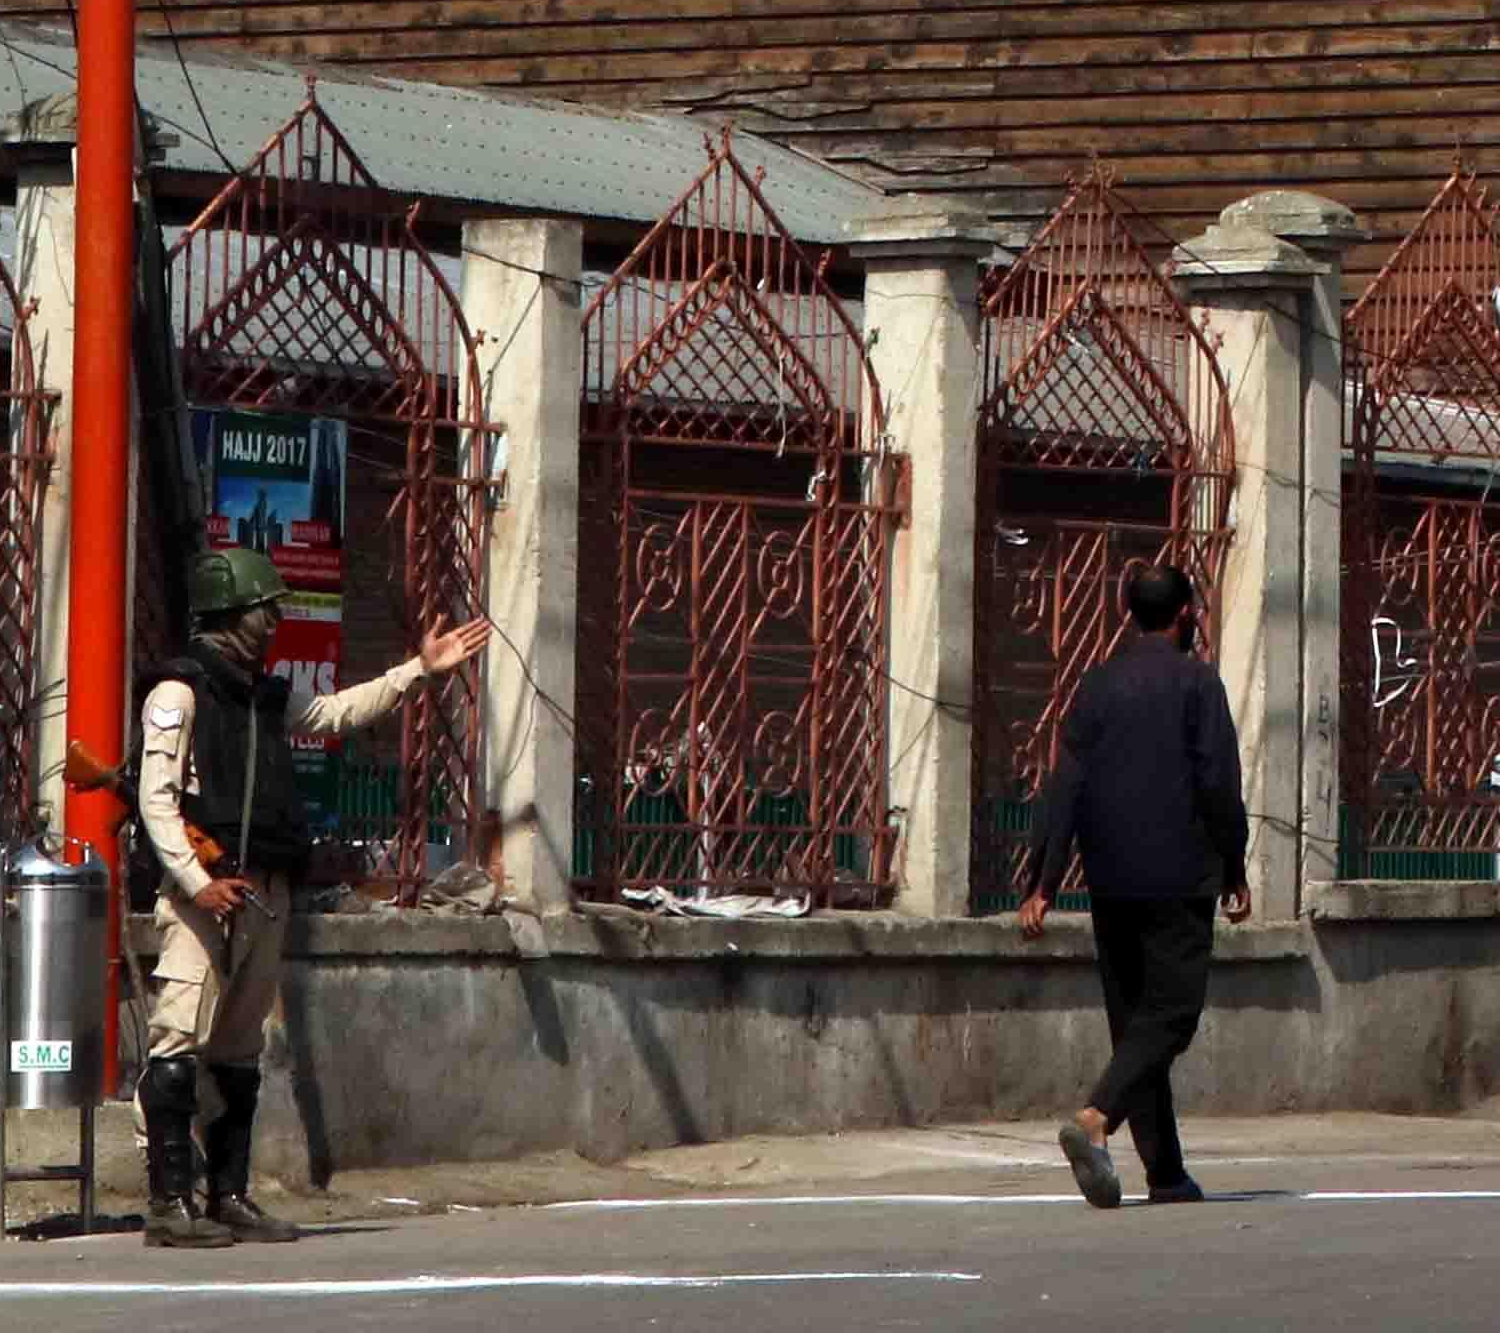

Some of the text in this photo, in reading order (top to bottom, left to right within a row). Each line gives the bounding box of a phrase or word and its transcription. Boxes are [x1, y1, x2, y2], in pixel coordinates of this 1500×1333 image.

[222, 429, 307, 465] HAJJ 2017
[18, 1044, 69, 1064] S.M.C
